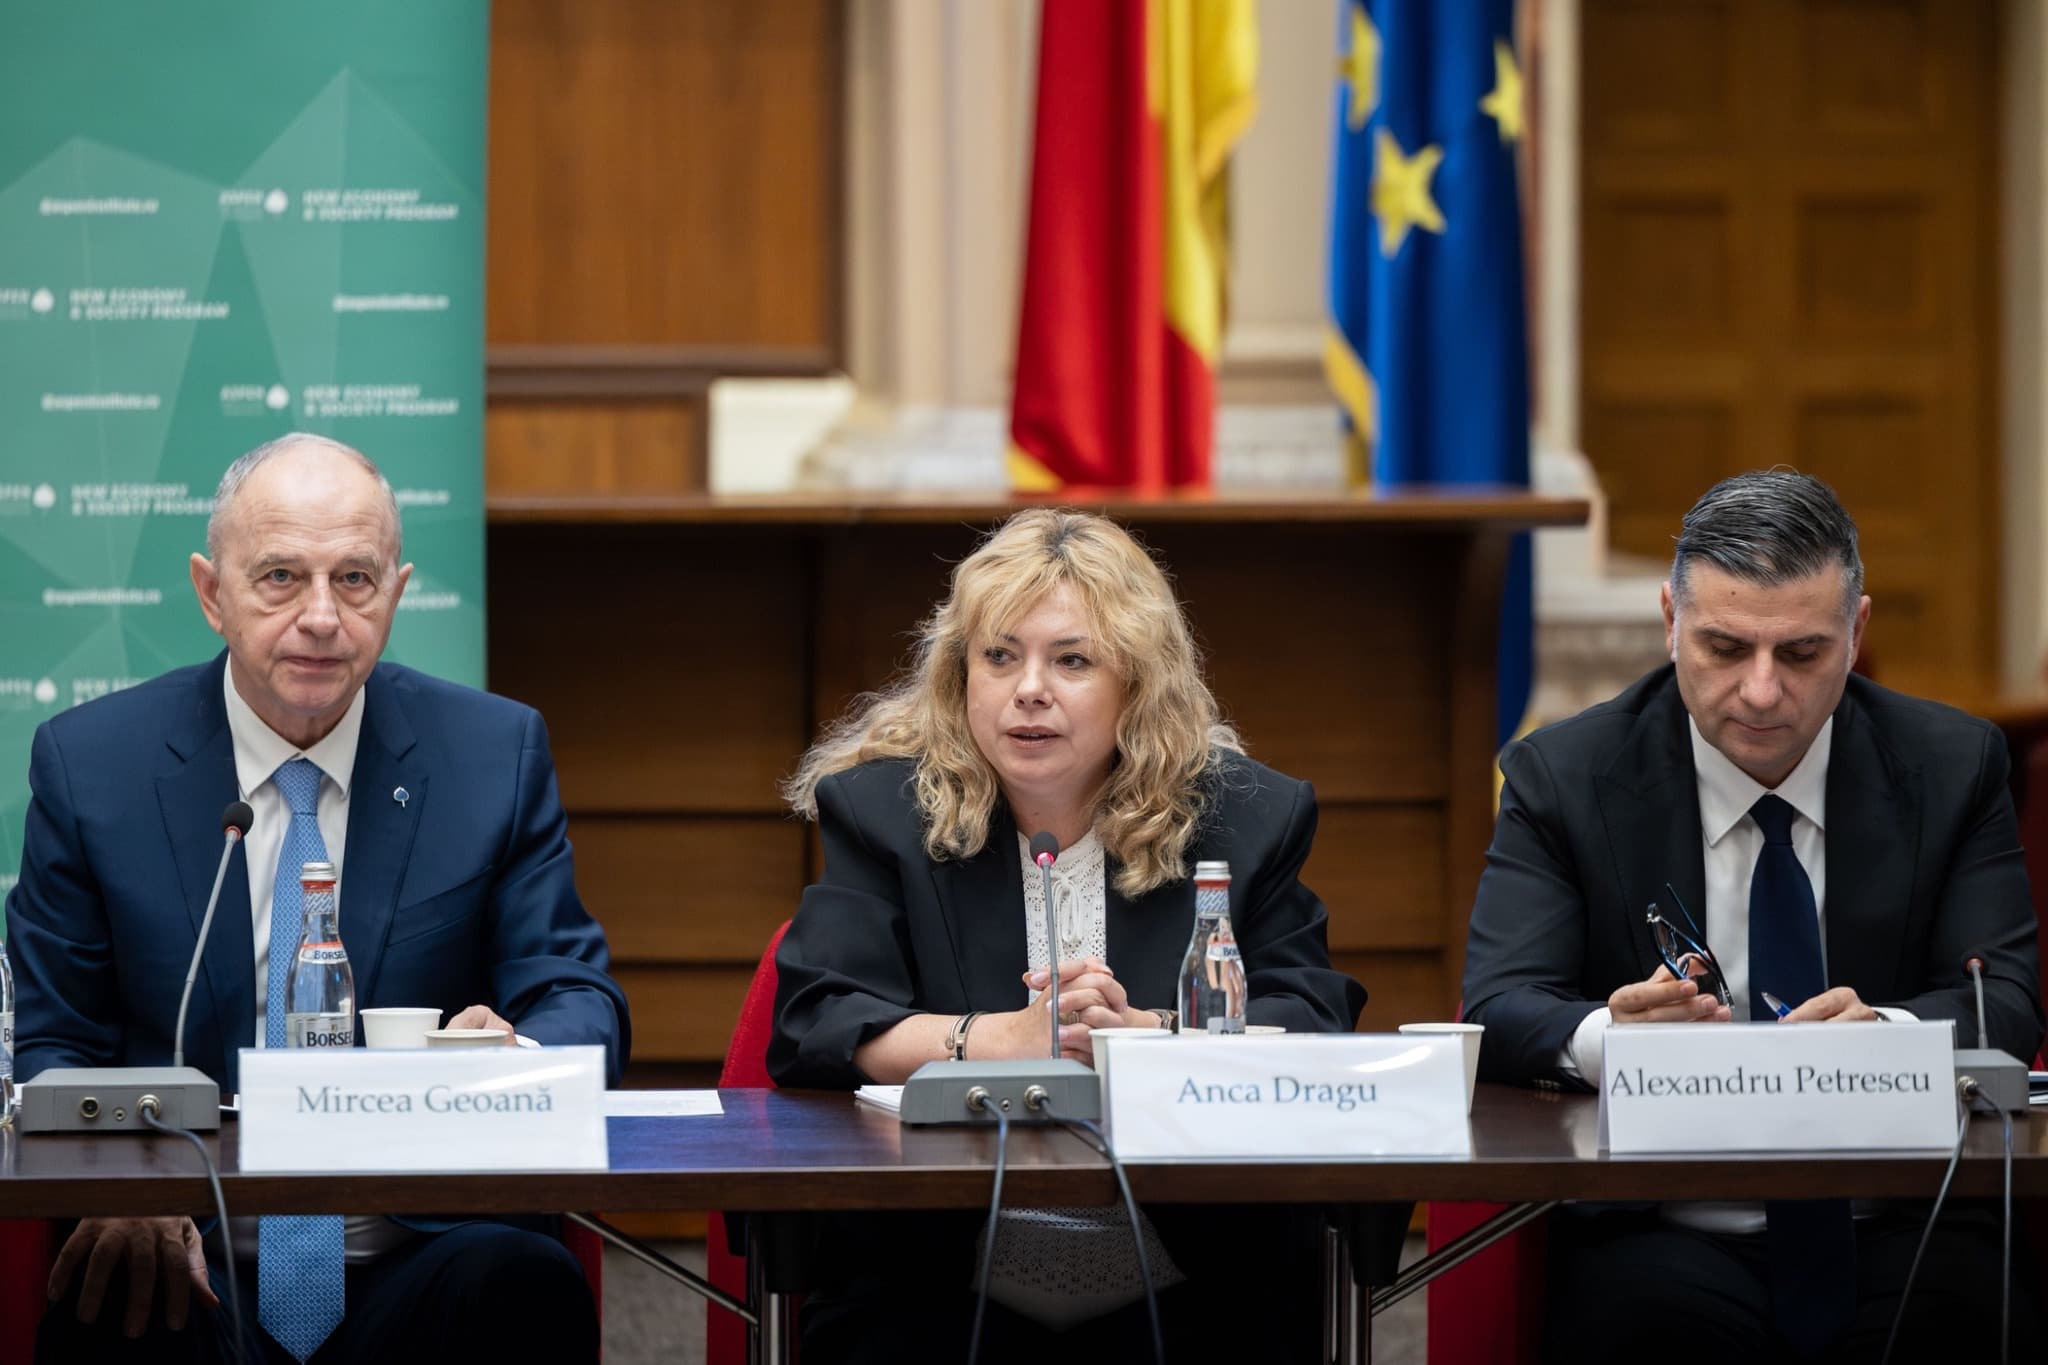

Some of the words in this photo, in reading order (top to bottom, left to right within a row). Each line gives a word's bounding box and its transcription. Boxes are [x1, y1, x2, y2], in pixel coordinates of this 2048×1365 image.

[1177, 1077, 1261, 1103] Anca
[1273, 1076, 1377, 1112] Dragu
[1610, 1067, 1783, 1097] Alexandru
[1793, 1065, 1931, 1094] Petrescu
[297, 1086, 412, 1113] Mircea
[424, 1084, 553, 1113] Geoană
